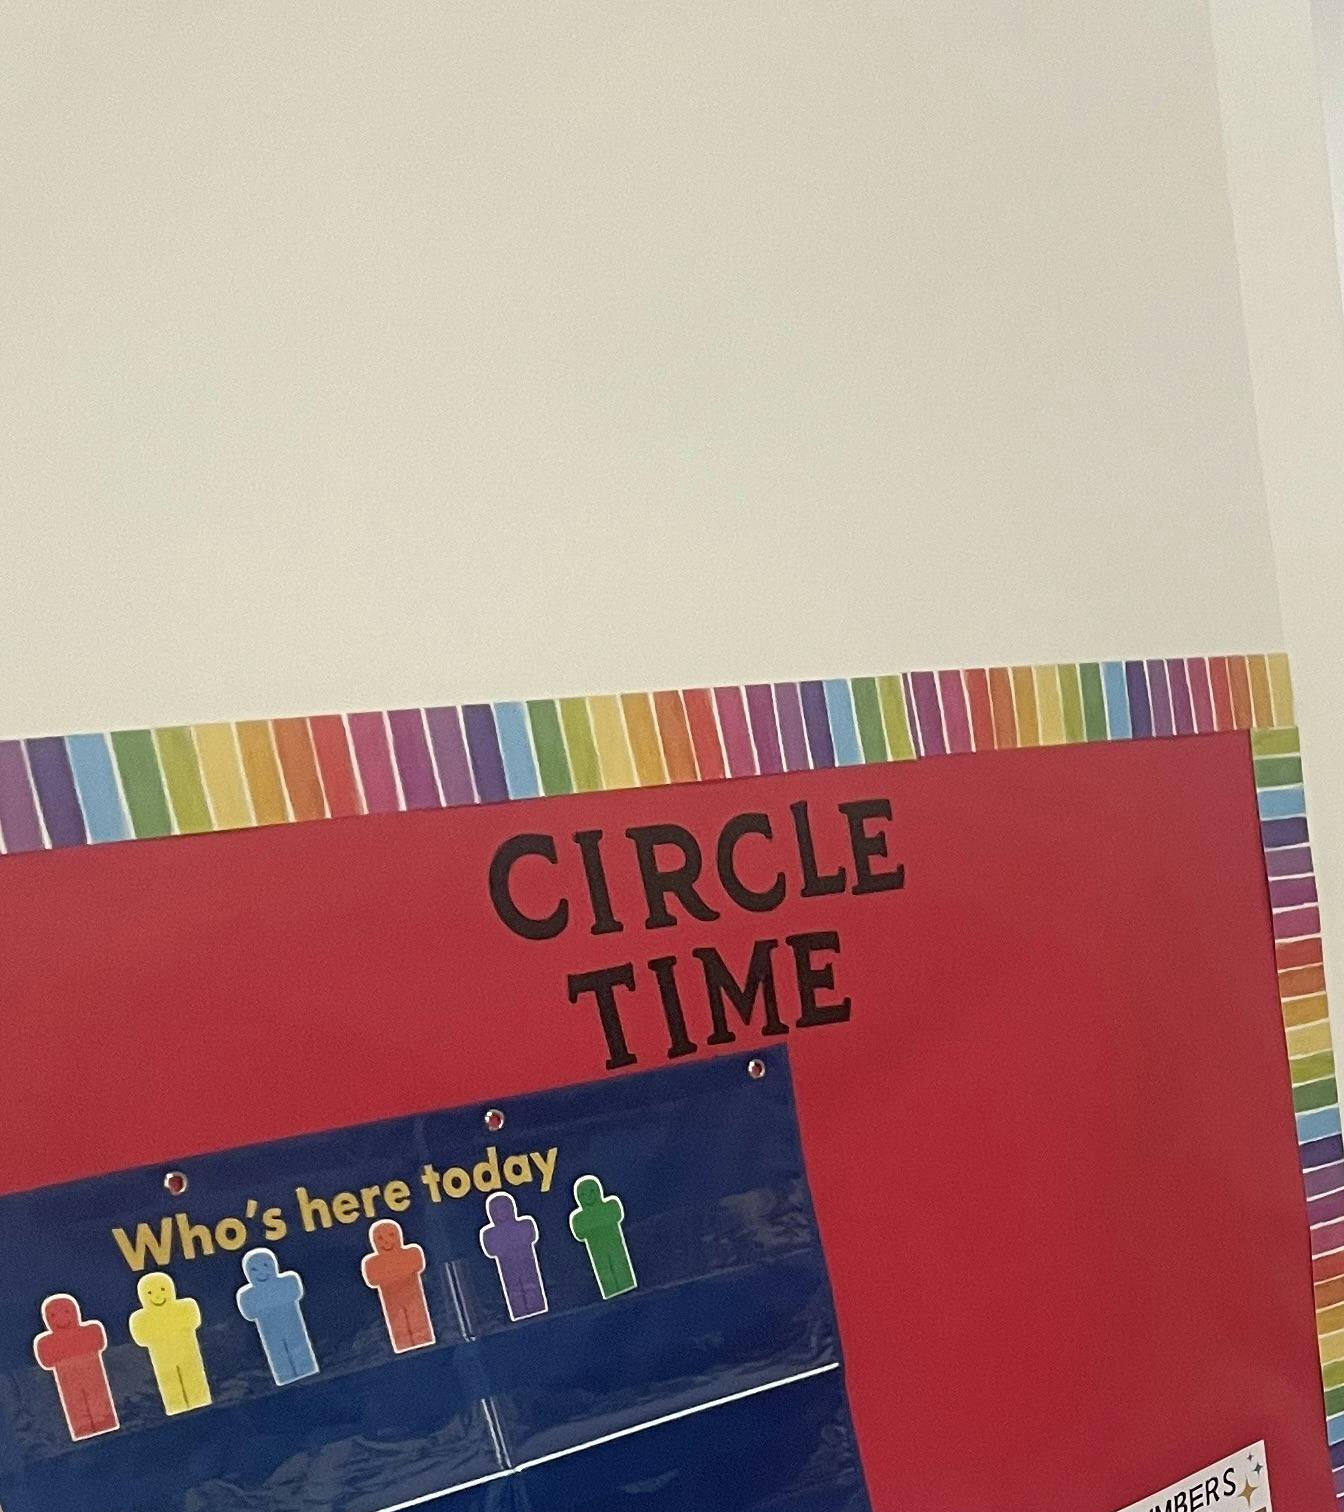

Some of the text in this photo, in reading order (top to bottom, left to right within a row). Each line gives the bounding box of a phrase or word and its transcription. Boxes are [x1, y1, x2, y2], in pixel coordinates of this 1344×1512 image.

[487, 798, 906, 941] CIRCLE
[567, 930, 852, 1071] TIME
[111, 1145, 558, 1273] Who's here today
